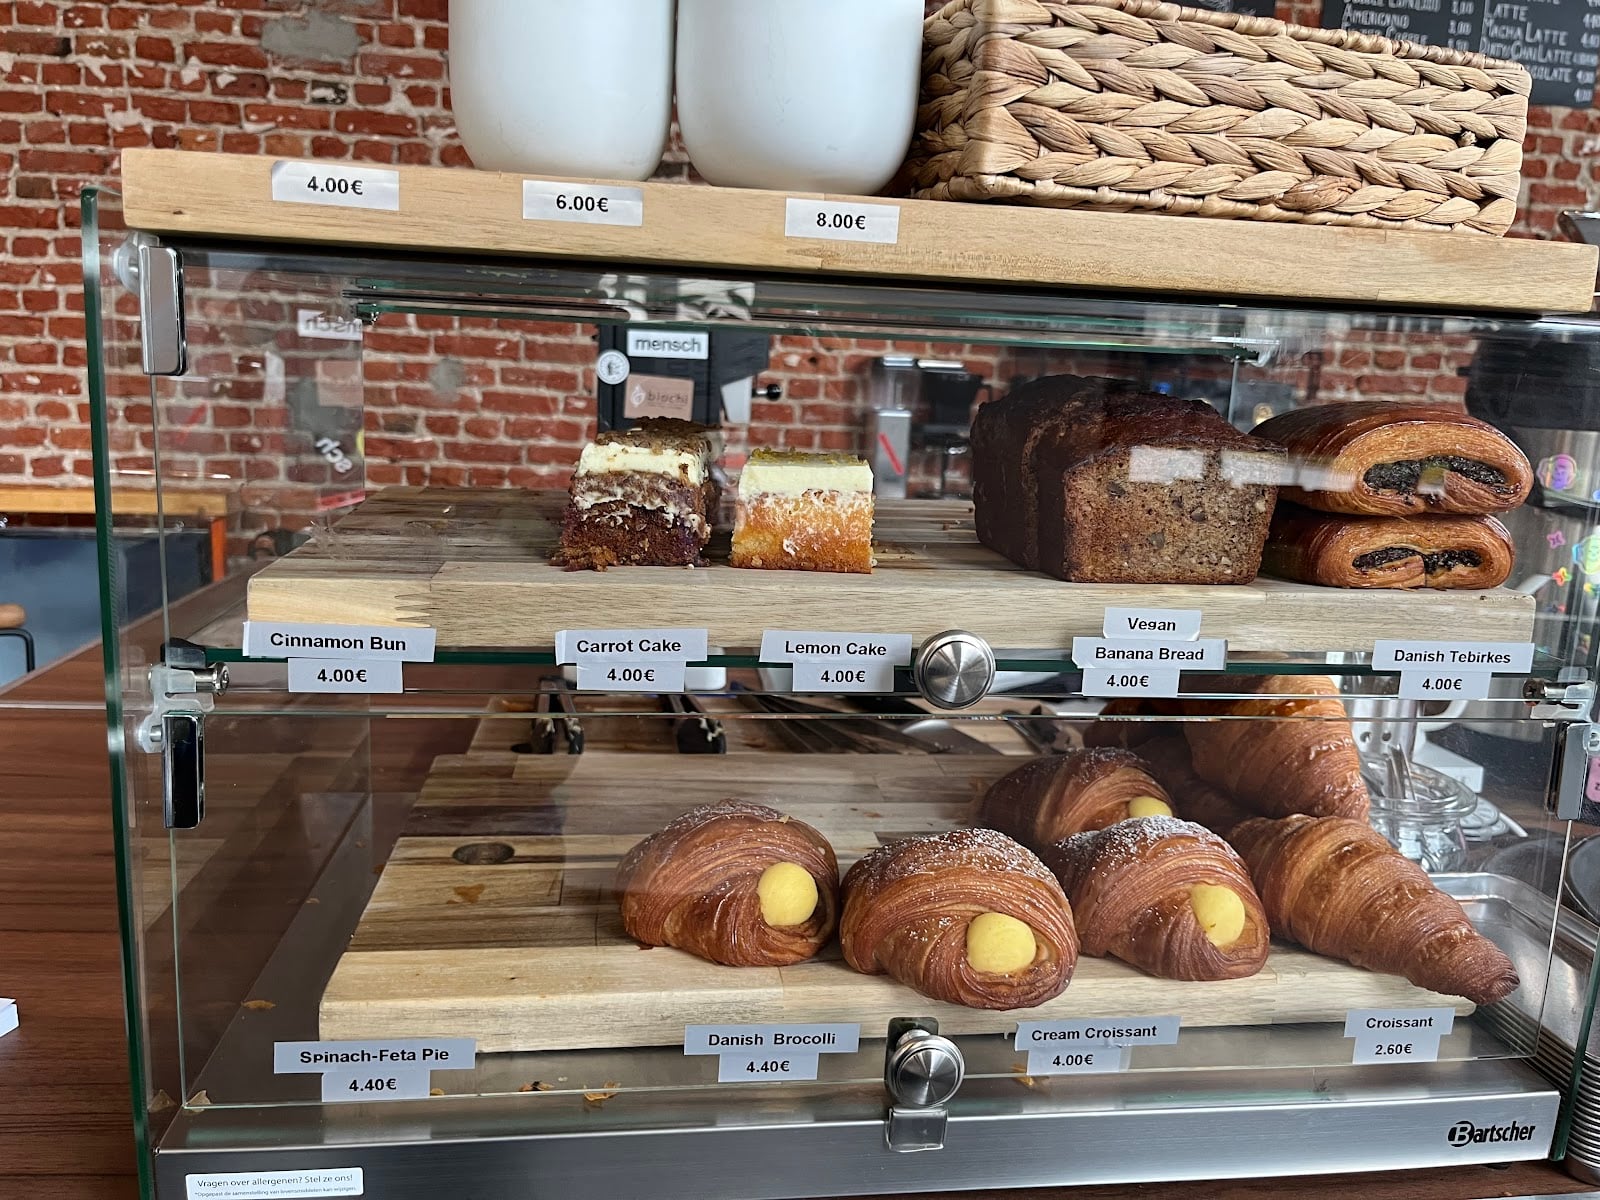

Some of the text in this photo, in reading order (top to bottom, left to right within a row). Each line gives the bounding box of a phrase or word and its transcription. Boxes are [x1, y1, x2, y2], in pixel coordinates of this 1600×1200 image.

[1484, 0, 1529, 22] LATTE
[1525, 21, 1568, 46] LATTE
[1538, 44, 1573, 65] LATTE
[306, 176, 363, 196] 4.00€
[555, 194, 609, 213] 6.00€
[816, 212, 866, 230] 8.00€
[635, 338, 701, 353] mensch
[1127, 617, 1176, 632] Vegan
[270, 632, 407, 651] Cinnamon Bun
[577, 638, 682, 653] Carrot Cake
[784, 640, 887, 656] Lemon Cake
[1095, 647, 1204, 661] Banana Bread
[1394, 649, 1511, 664] Danish Tebirkes
[316, 668, 368, 683] 4.00€
[606, 667, 655, 682] 4.00€
[820, 669, 866, 684] 4.00€
[1106, 674, 1149, 687] 4.00€
[1422, 678, 1463, 690] 4.00€
[1366, 1016, 1434, 1029] Croissant
[708, 1033, 836, 1046] Danish Brocolli
[1031, 1025, 1158, 1041] Cream Croissant
[300, 1048, 449, 1064] Spinach-Feta Pie
[1375, 1043, 1413, 1055] 2.60€
[746, 1060, 790, 1073] 4.40€
[1052, 1054, 1094, 1066] 4.00€
[349, 1078, 397, 1092] 4.40€
[1447, 1120, 1536, 1148] Bartscher
[197, 1179, 229, 1189] Vragen
[230, 1179, 249, 1187] over
[252, 1176, 302, 1187] allergenen?
[304, 1175, 321, 1184] Stel
[334, 1174, 353, 1183] ons!
